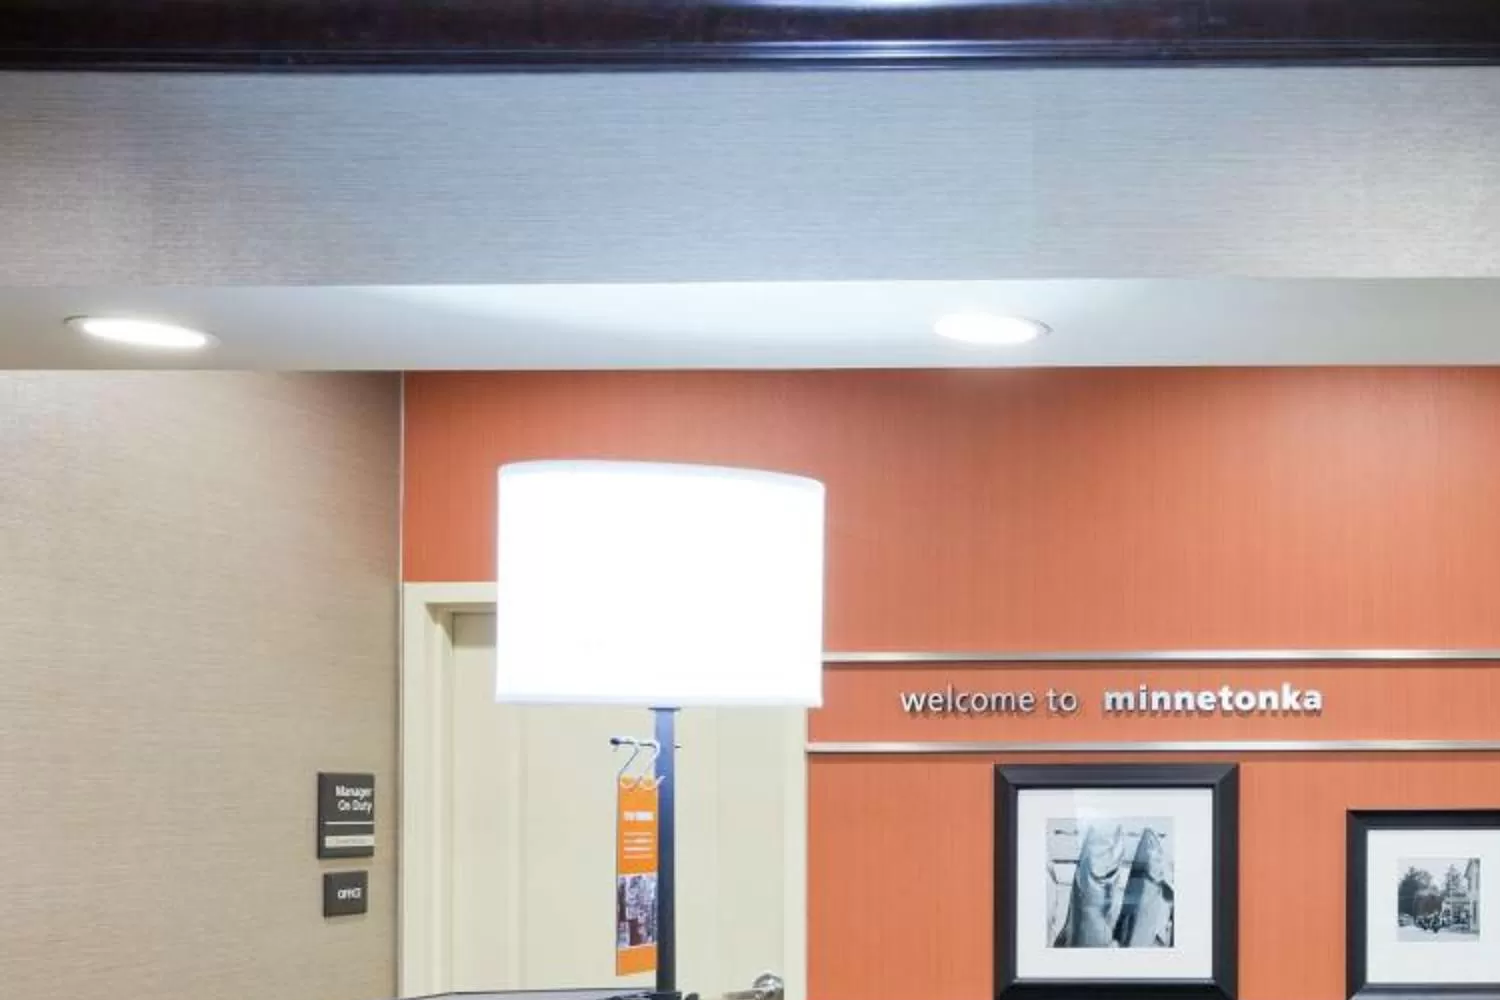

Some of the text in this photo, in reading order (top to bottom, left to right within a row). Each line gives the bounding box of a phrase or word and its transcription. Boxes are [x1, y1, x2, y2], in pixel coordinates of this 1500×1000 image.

[900, 682, 1323, 713] welcome to minnetonka
